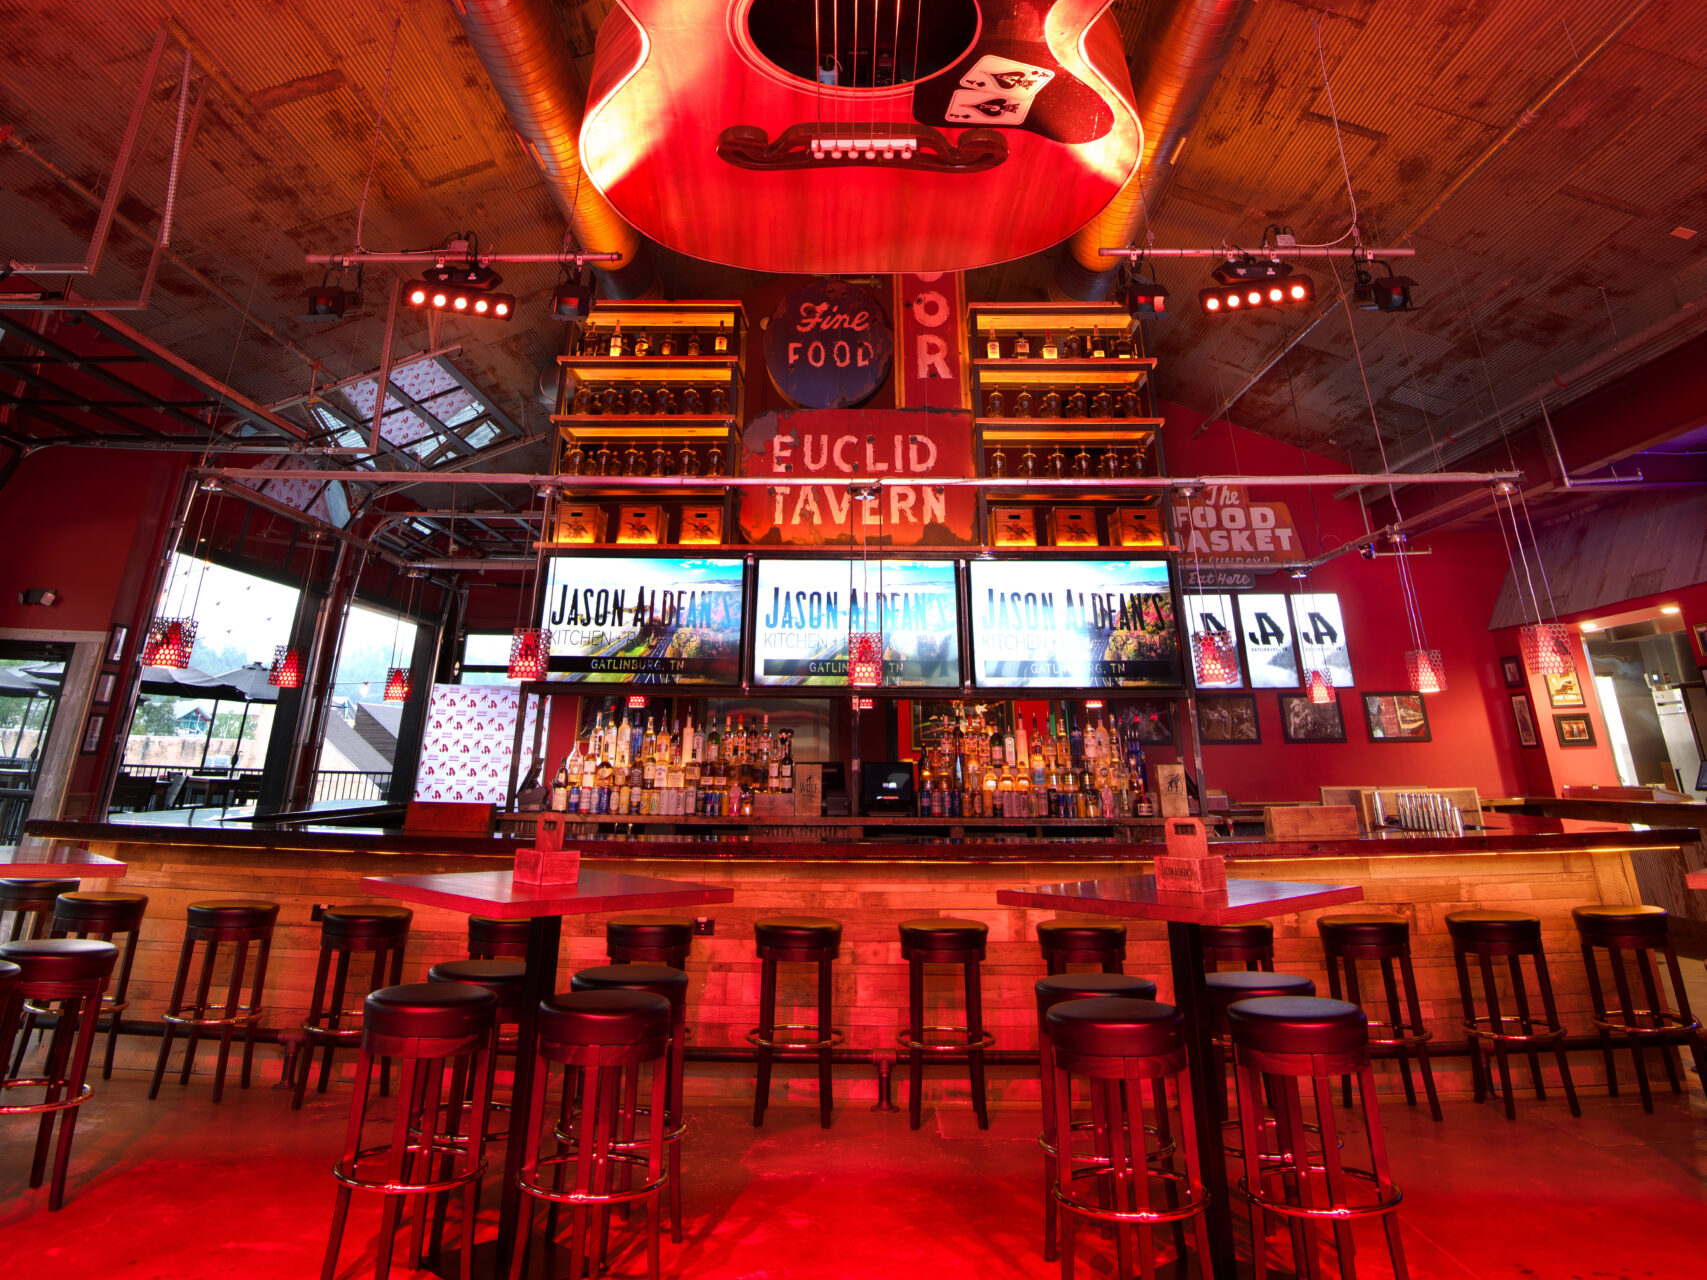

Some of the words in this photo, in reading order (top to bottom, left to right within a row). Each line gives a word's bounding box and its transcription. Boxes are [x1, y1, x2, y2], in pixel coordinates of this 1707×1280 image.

[796, 301, 871, 332] Fine
[788, 340, 874, 368] FOOD
[772, 433, 938, 473] EUCLID
[767, 485, 946, 526] TAVERN
[1205, 485, 1240, 506] The
[1172, 505, 1276, 529] FOOD
[1189, 571, 1215, 585] Eat
[1217, 572, 1251, 585] Here
[551, 584, 626, 627] JASON
[765, 586, 839, 630] JASON
[982, 588, 1056, 631] JASON
[550, 630, 612, 646] KITCHEN
[764, 632, 828, 649] KITCHEN
[670, 659, 685, 671] TN
[889, 662, 904, 673] TN
[1110, 664, 1126, 674] TN
